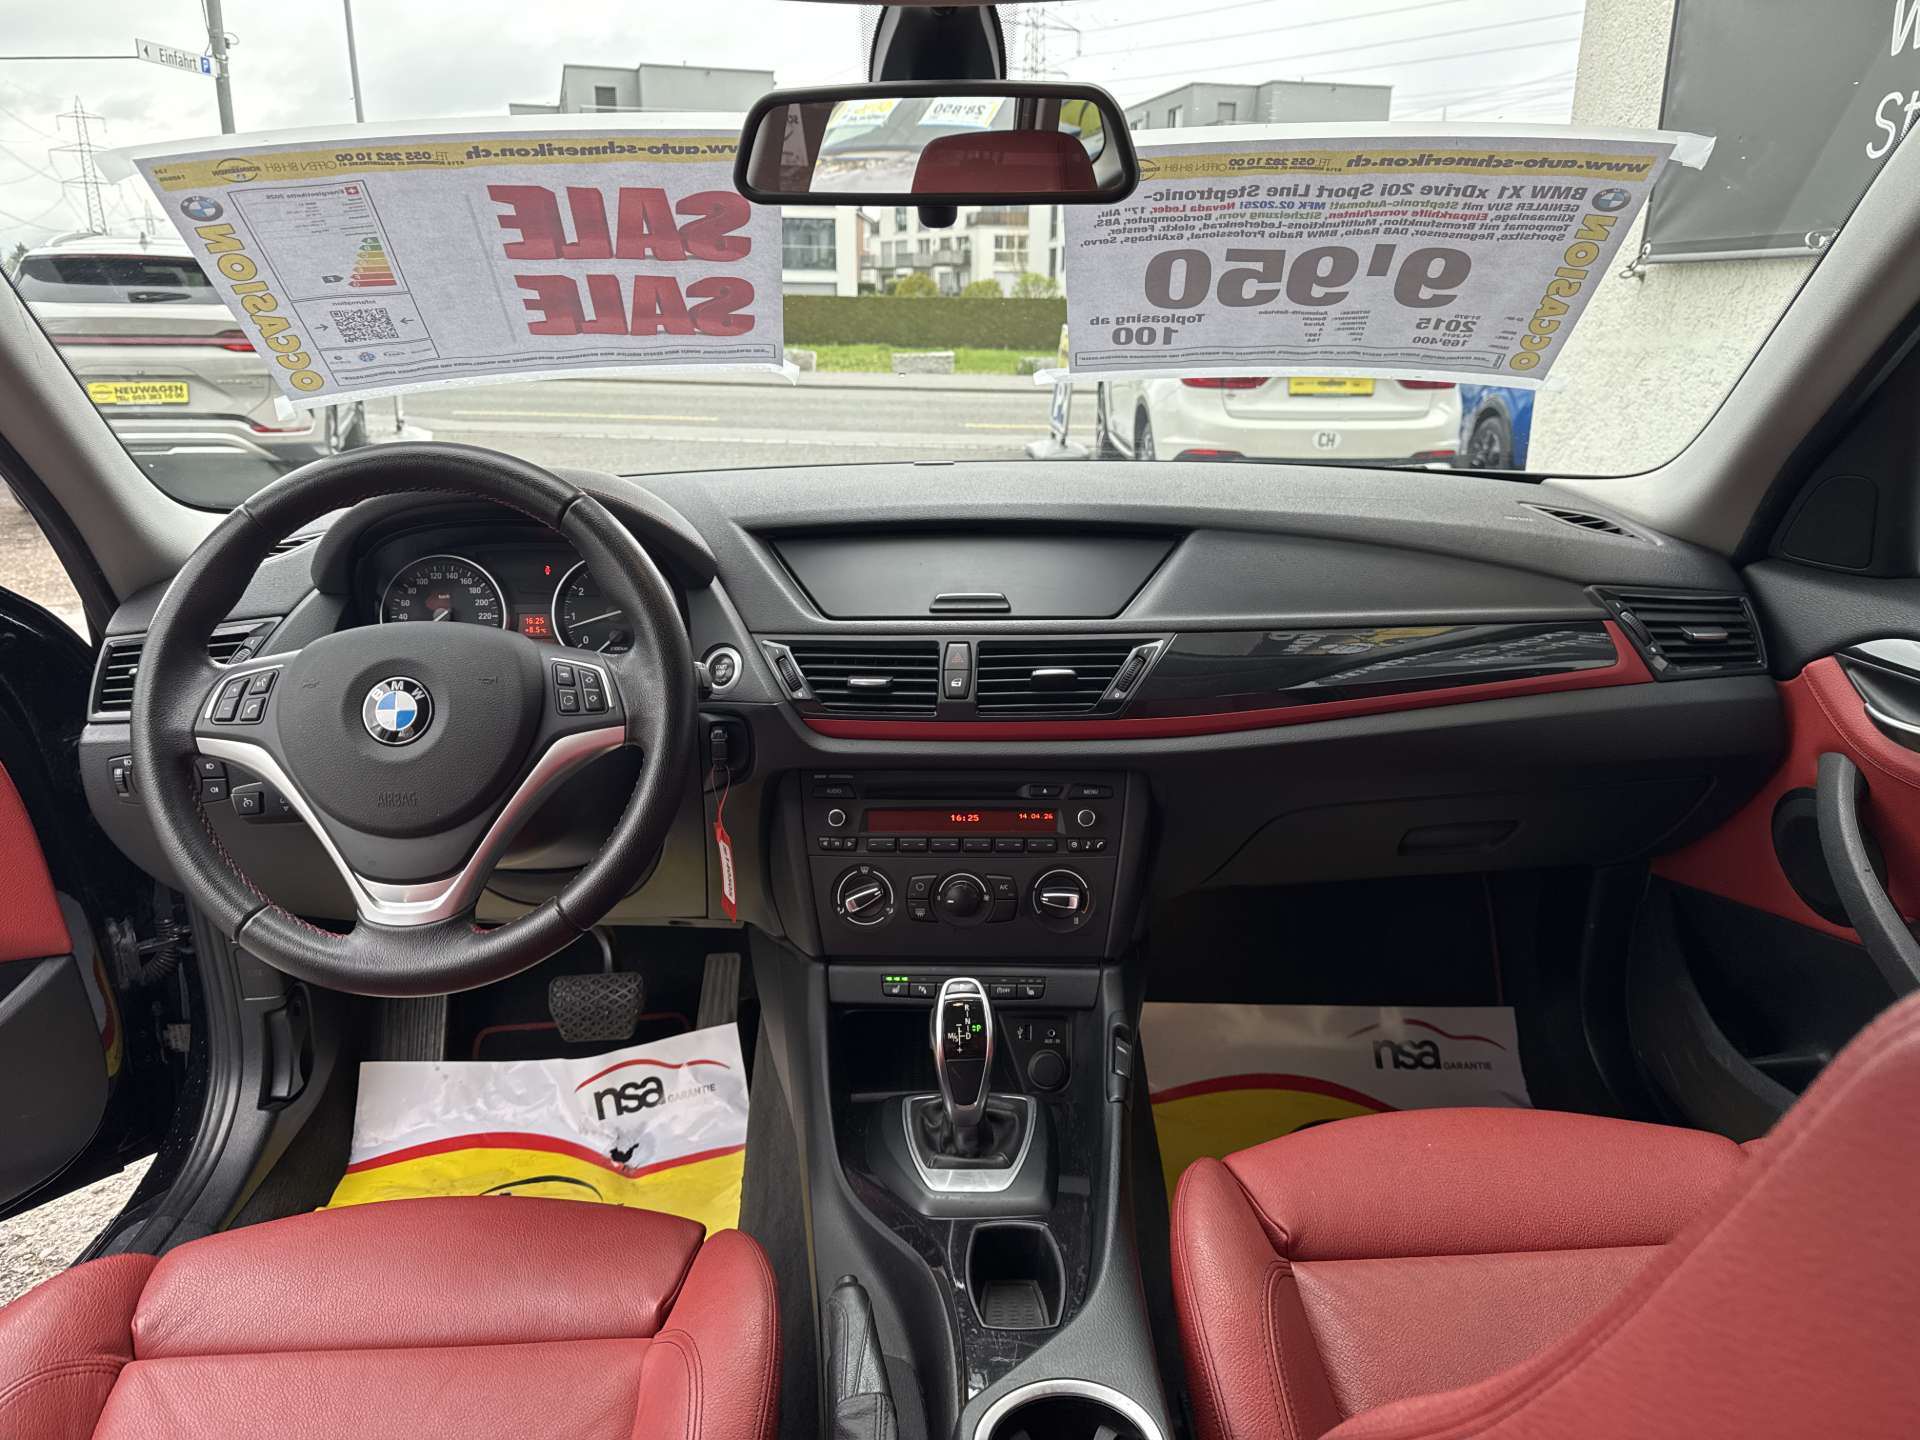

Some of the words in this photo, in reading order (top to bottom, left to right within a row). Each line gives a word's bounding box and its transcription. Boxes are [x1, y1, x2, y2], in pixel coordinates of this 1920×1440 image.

[159, 47, 198, 72] Einfahrt
[115, 384, 184, 395] NEUWAGEN
[1318, 432, 1336, 448] CH
[429, 572, 442, 580] 120
[446, 572, 459, 580] 140
[416, 577, 429, 585] 100
[460, 577, 473, 585] 160
[468, 586, 482, 594] 180
[578, 587, 585, 596] 2
[400, 599, 411, 607] 60
[474, 598, 489, 607] 200
[398, 612, 409, 620] 40
[478, 612, 492, 621] 220
[525, 617, 545, 625] 16:25
[583, 636, 590, 644] 0
[370, 681, 425, 702] BMW
[376, 791, 418, 809] AIRBAG
[950, 813, 981, 822] 16:25
[1372, 1040, 1441, 1070] nsa
[1443, 1061, 1492, 1071] GARANTIE
[594, 1076, 665, 1121] nsa
[667, 1083, 717, 1104] GARANTIE
